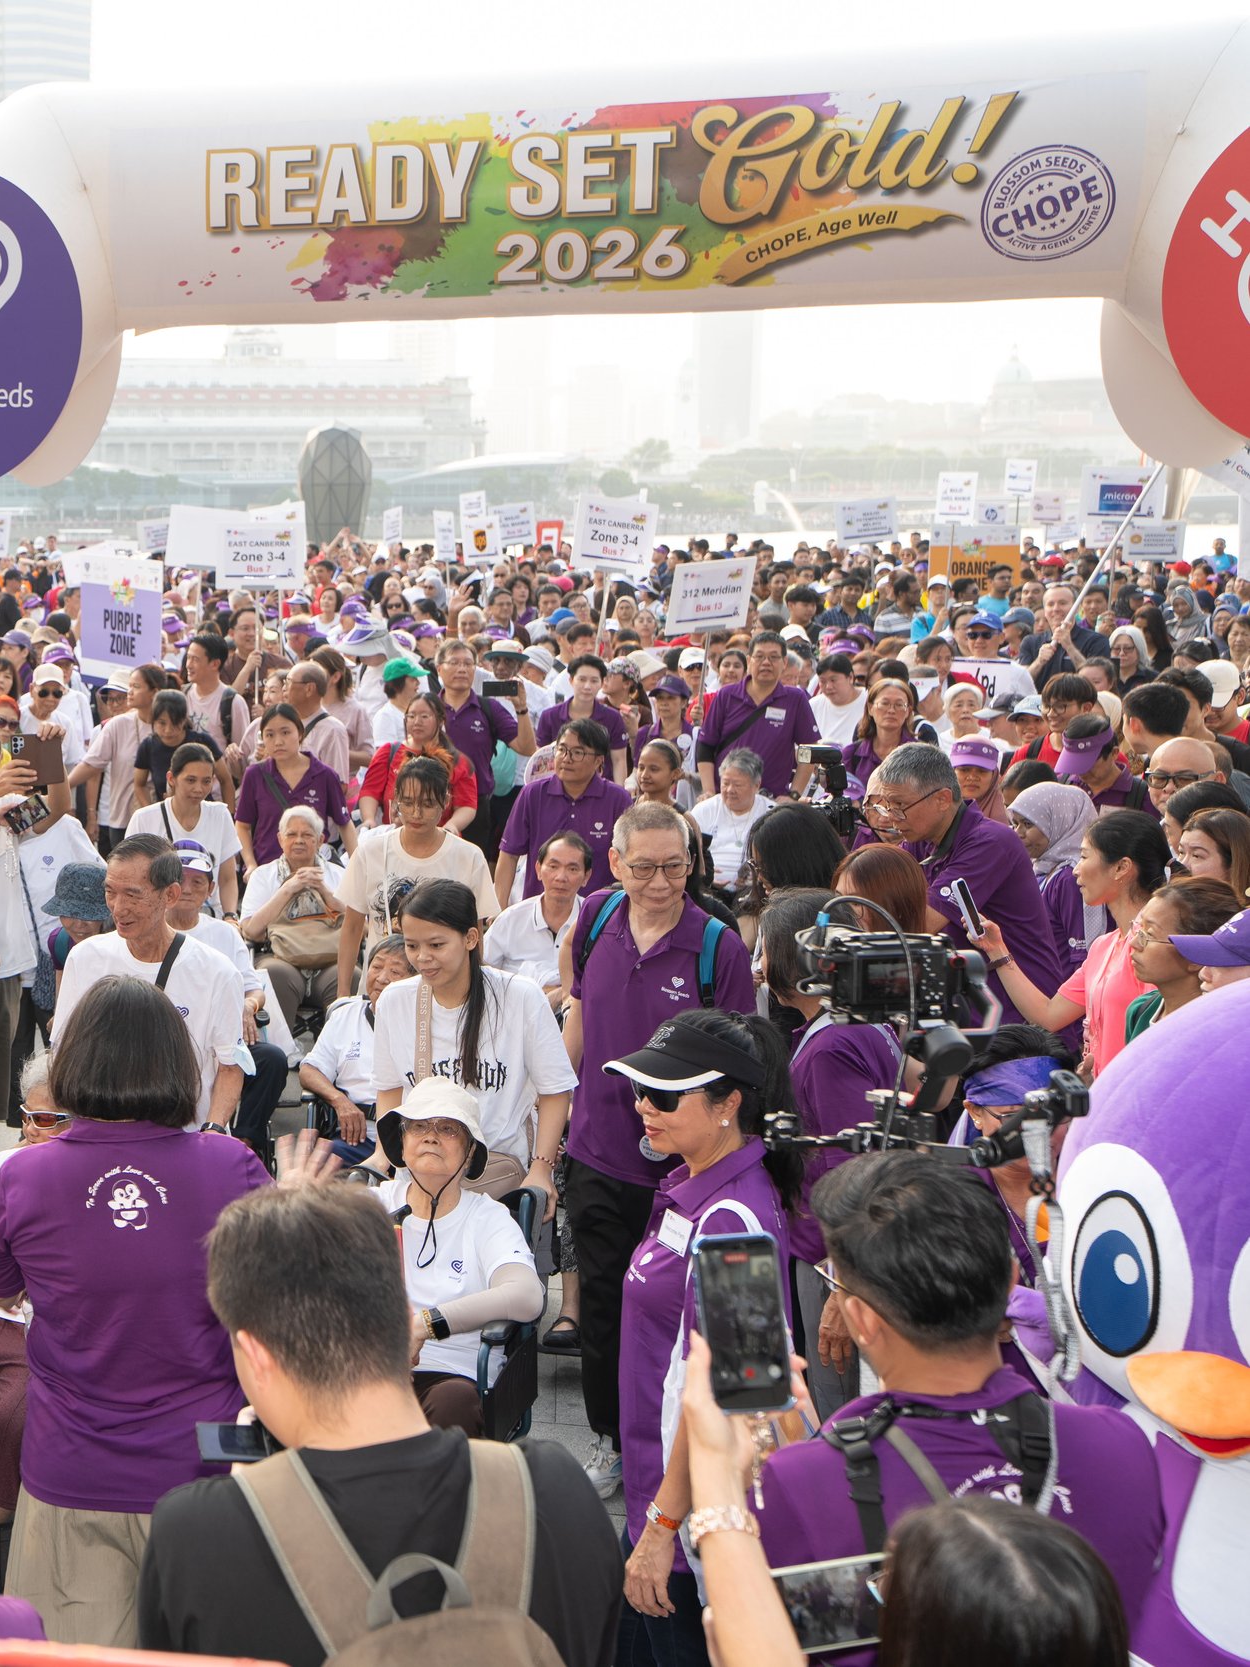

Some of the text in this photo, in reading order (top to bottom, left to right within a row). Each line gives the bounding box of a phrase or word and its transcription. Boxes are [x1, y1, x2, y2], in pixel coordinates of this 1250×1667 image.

[206, 91, 1021, 233] READY SET Gold!
[994, 156, 1087, 209] BLOSSOM SEEDS
[992, 175, 1103, 238] CHOPE
[745, 210, 898, 263] CHOPE, Age Well
[1006, 204, 1101, 251] ACTIVE AGEING CENTRE
[494, 225, 689, 285] 2026
[1102, 491, 1138, 500] micron
[588, 517, 645, 532] EAST CANBERRA
[590, 529, 639, 547] Zone 3-4
[602, 546, 617, 556] Bus
[232, 552, 286, 562] Zone 3-4
[682, 584, 742, 600] 312 Meridian
[695, 602, 723, 613] Bus 13
[103, 609, 143, 635] PURPLE
[110, 633, 136, 658] ZONE
[420, 984, 429, 1015] GUESS
[85, 1165, 169, 1209] To Serve with Love and Care
